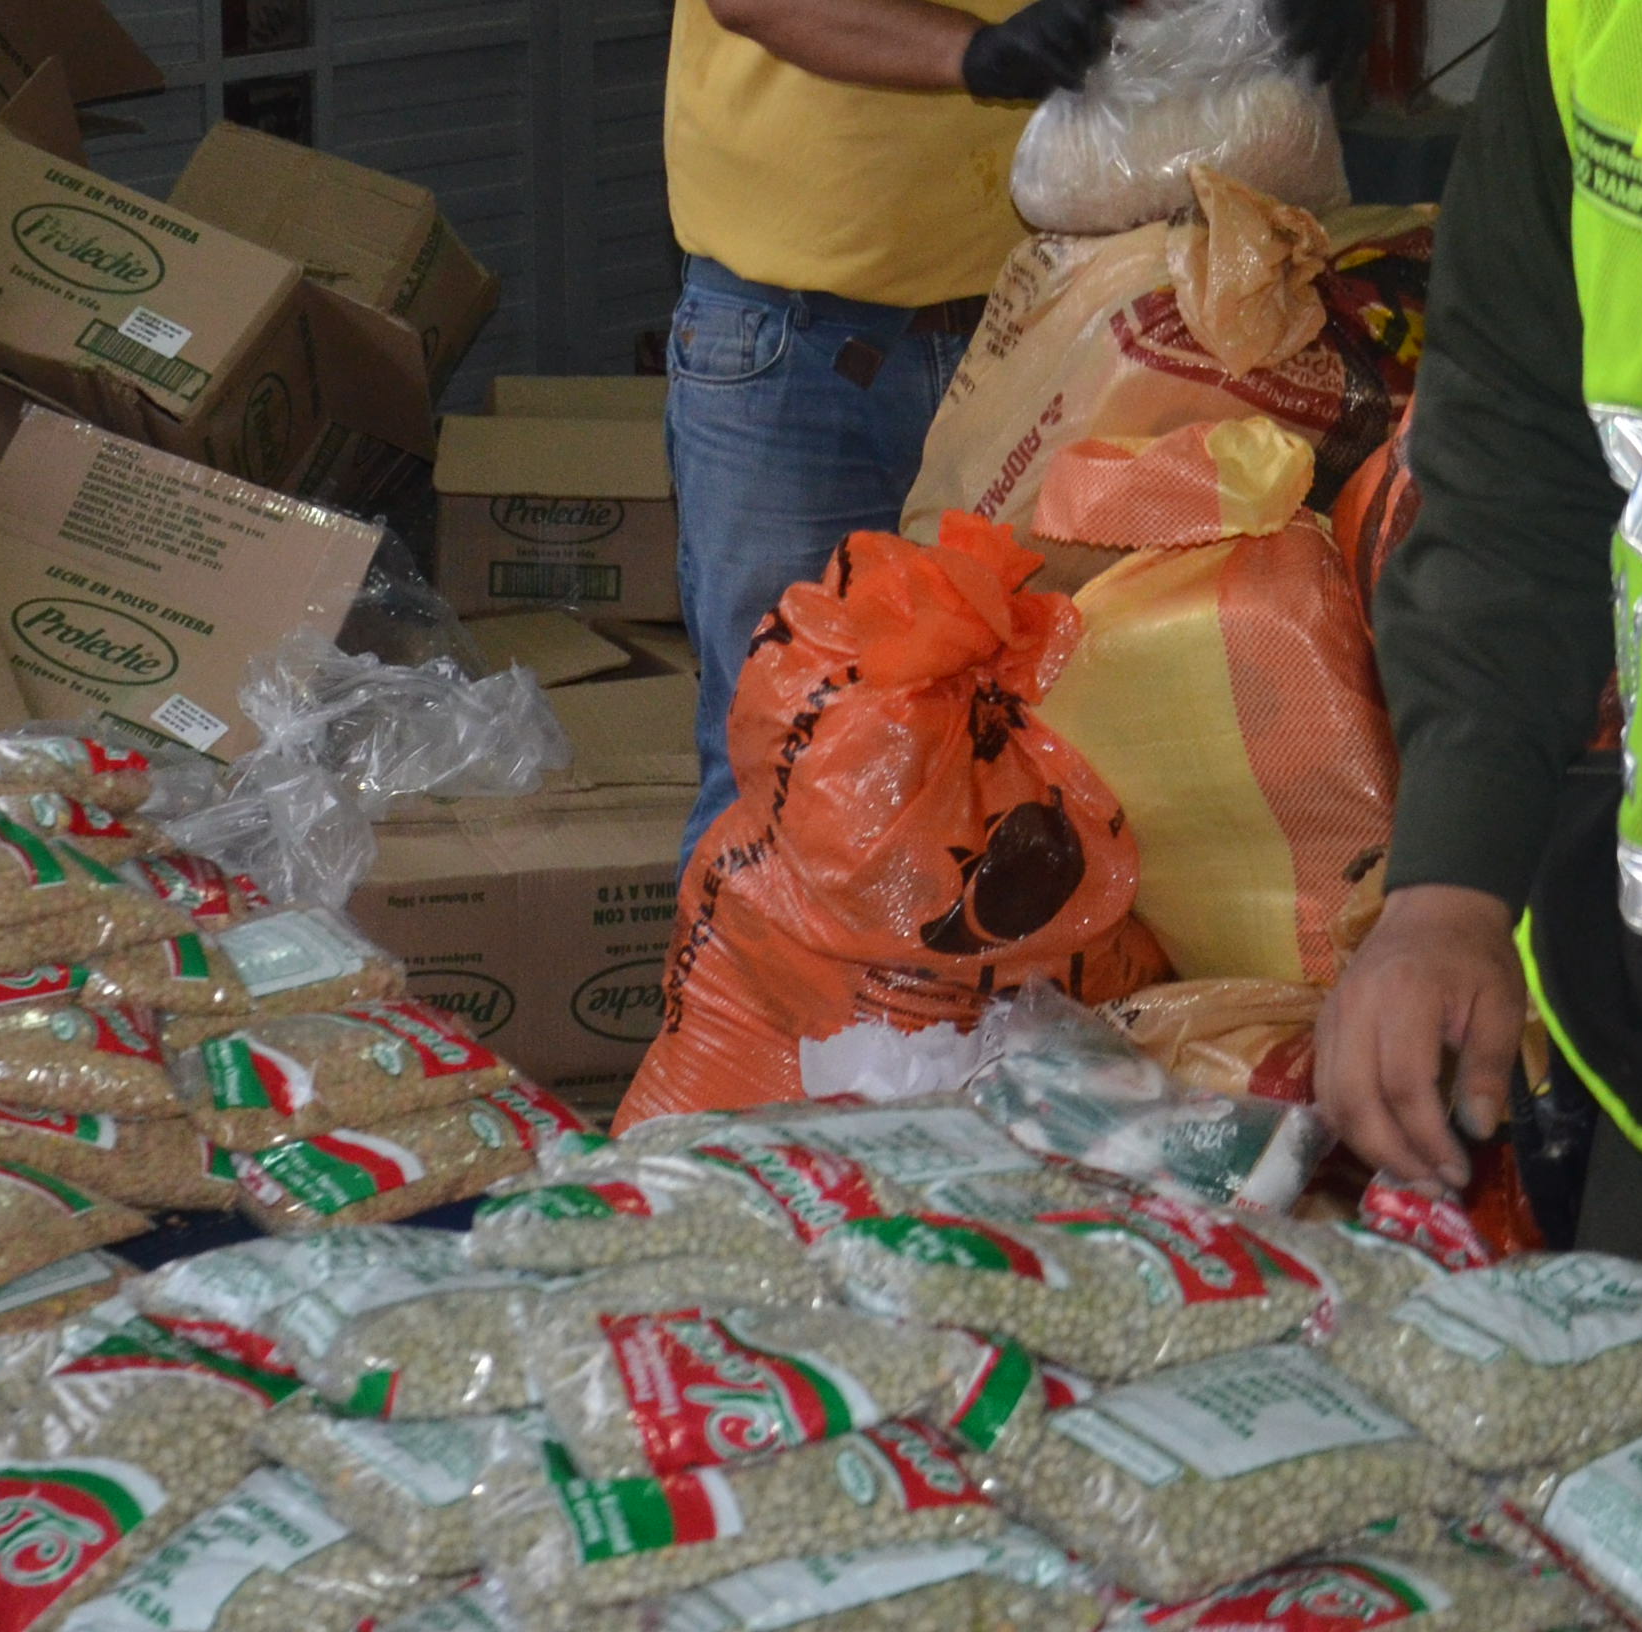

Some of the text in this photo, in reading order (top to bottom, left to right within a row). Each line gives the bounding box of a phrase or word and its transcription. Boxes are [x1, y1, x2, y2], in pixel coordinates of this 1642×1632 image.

[43, 166, 199, 245] LECHE EN POLVO ENTERA
[77, 294, 102, 313] vida
[45, 564, 215, 636] LECHE EN POLVO ENTERA
[84, 686, 112, 704] vida
[593, 908, 624, 924] CON
